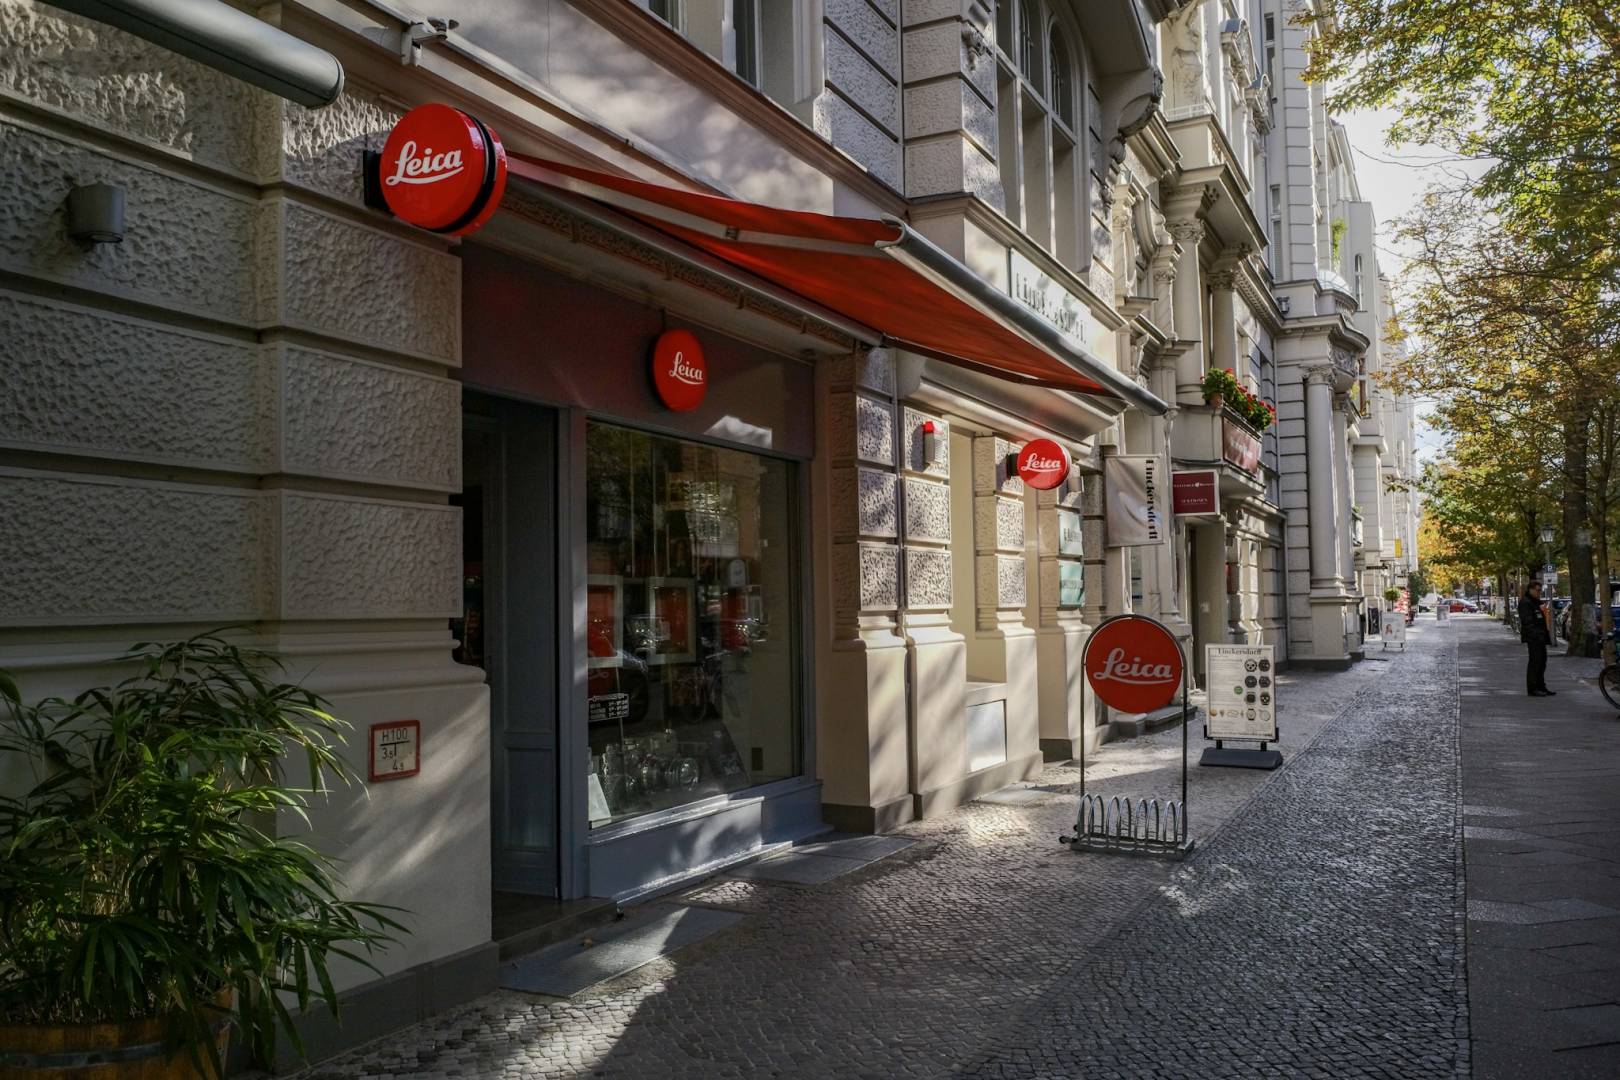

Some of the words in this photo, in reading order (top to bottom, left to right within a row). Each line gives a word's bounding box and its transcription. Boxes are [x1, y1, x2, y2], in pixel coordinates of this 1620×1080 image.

[385, 140, 464, 186] Leica
[669, 351, 704, 385] Leica
[1020, 452, 1062, 472] Leica
[1093, 647, 1175, 685] Leica
